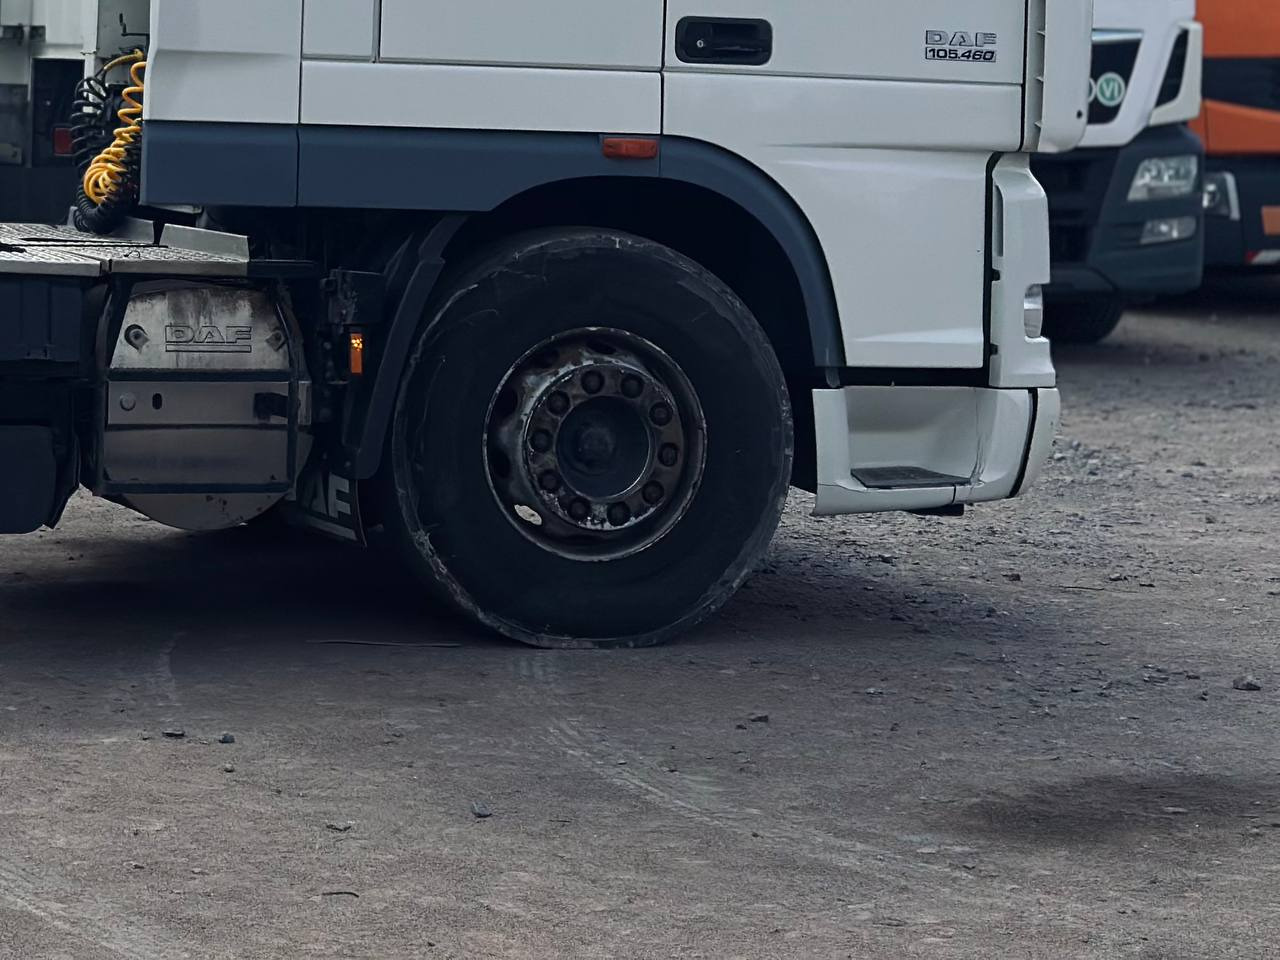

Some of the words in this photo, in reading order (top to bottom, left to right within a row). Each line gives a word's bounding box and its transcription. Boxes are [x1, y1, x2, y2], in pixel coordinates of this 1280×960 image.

[925, 30, 997, 47] DAF
[928, 48, 995, 61] 105.460
[165, 325, 252, 344] DAF
[303, 471, 351, 519] AF
